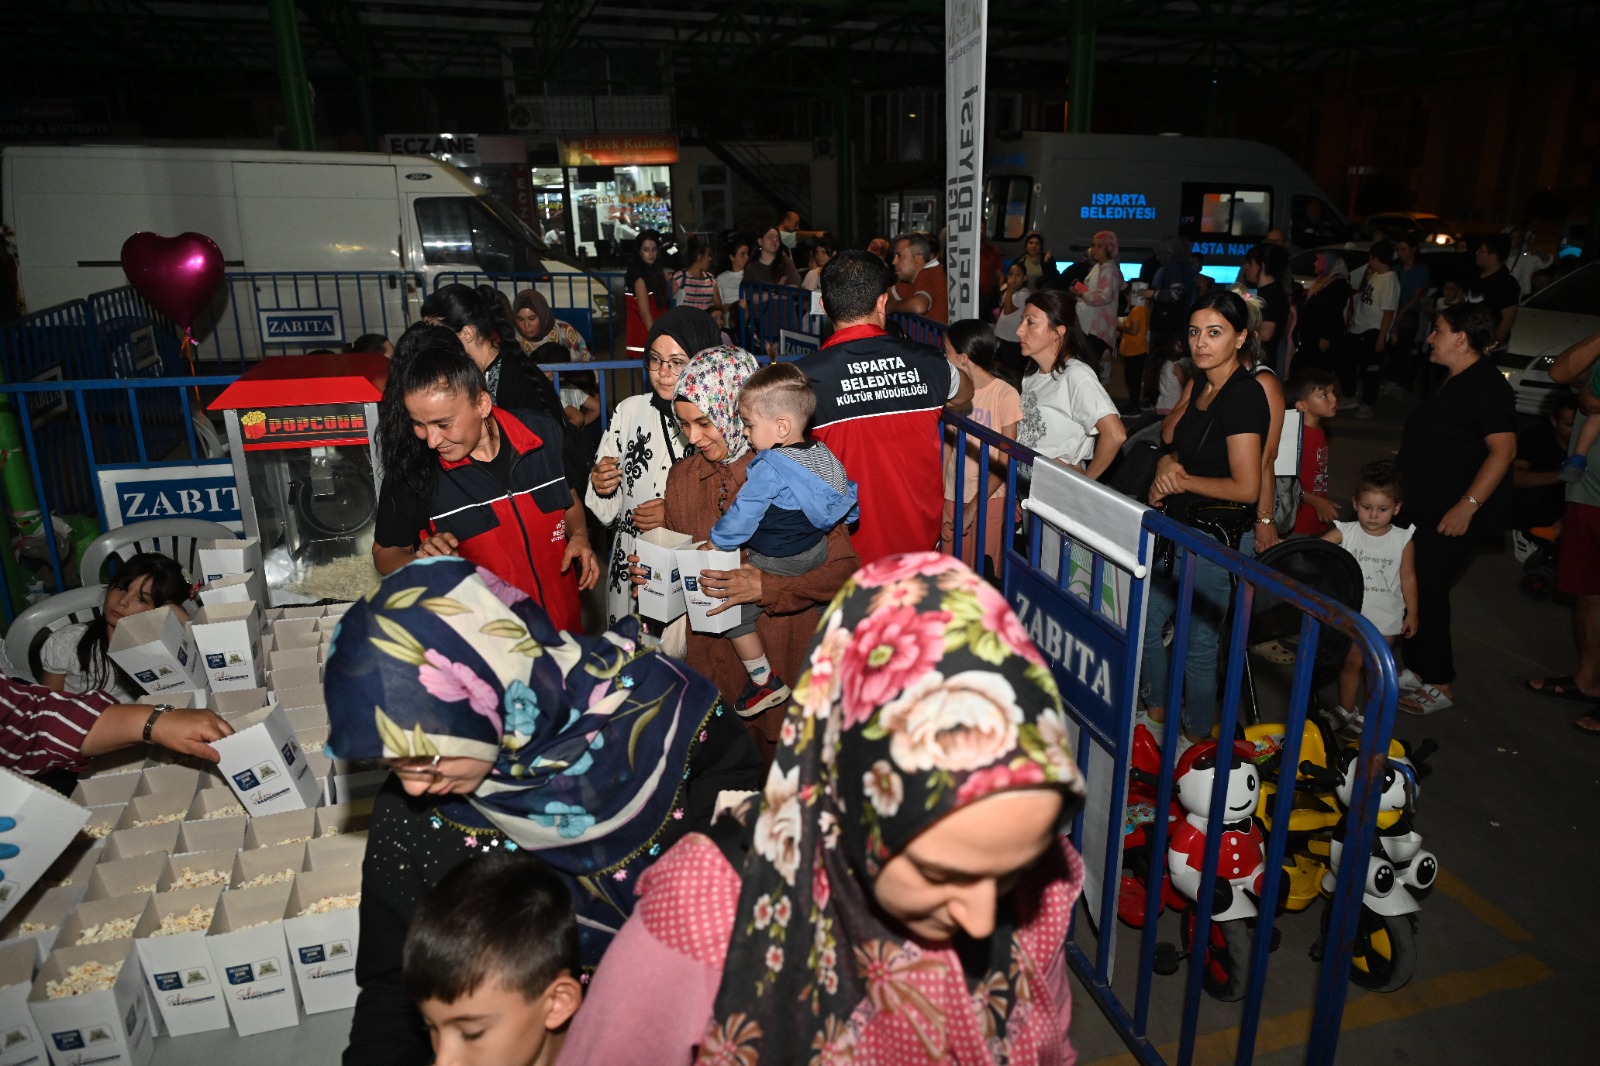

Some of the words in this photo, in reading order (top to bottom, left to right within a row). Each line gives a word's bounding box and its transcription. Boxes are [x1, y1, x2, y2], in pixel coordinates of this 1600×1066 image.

[390, 138, 475, 154] ECZANE
[584, 139, 620, 150] Erkek
[1091, 193, 1147, 207] ISPARTA
[1080, 205, 1156, 219] BELEDİYESİ
[1191, 242, 1225, 255] ASTA
[268, 319, 333, 334] ZABITA
[847, 356, 906, 375] ISPARTA
[840, 368, 920, 392] BELEDİYESİ
[836, 390, 874, 406] KÜLTÜR
[874, 384, 928, 400] MÜDÜRLÜĞÜ
[269, 414, 364, 432] POPCORN
[123, 487, 240, 518] ZABIT
[1016, 592, 1112, 706] ZABITA
